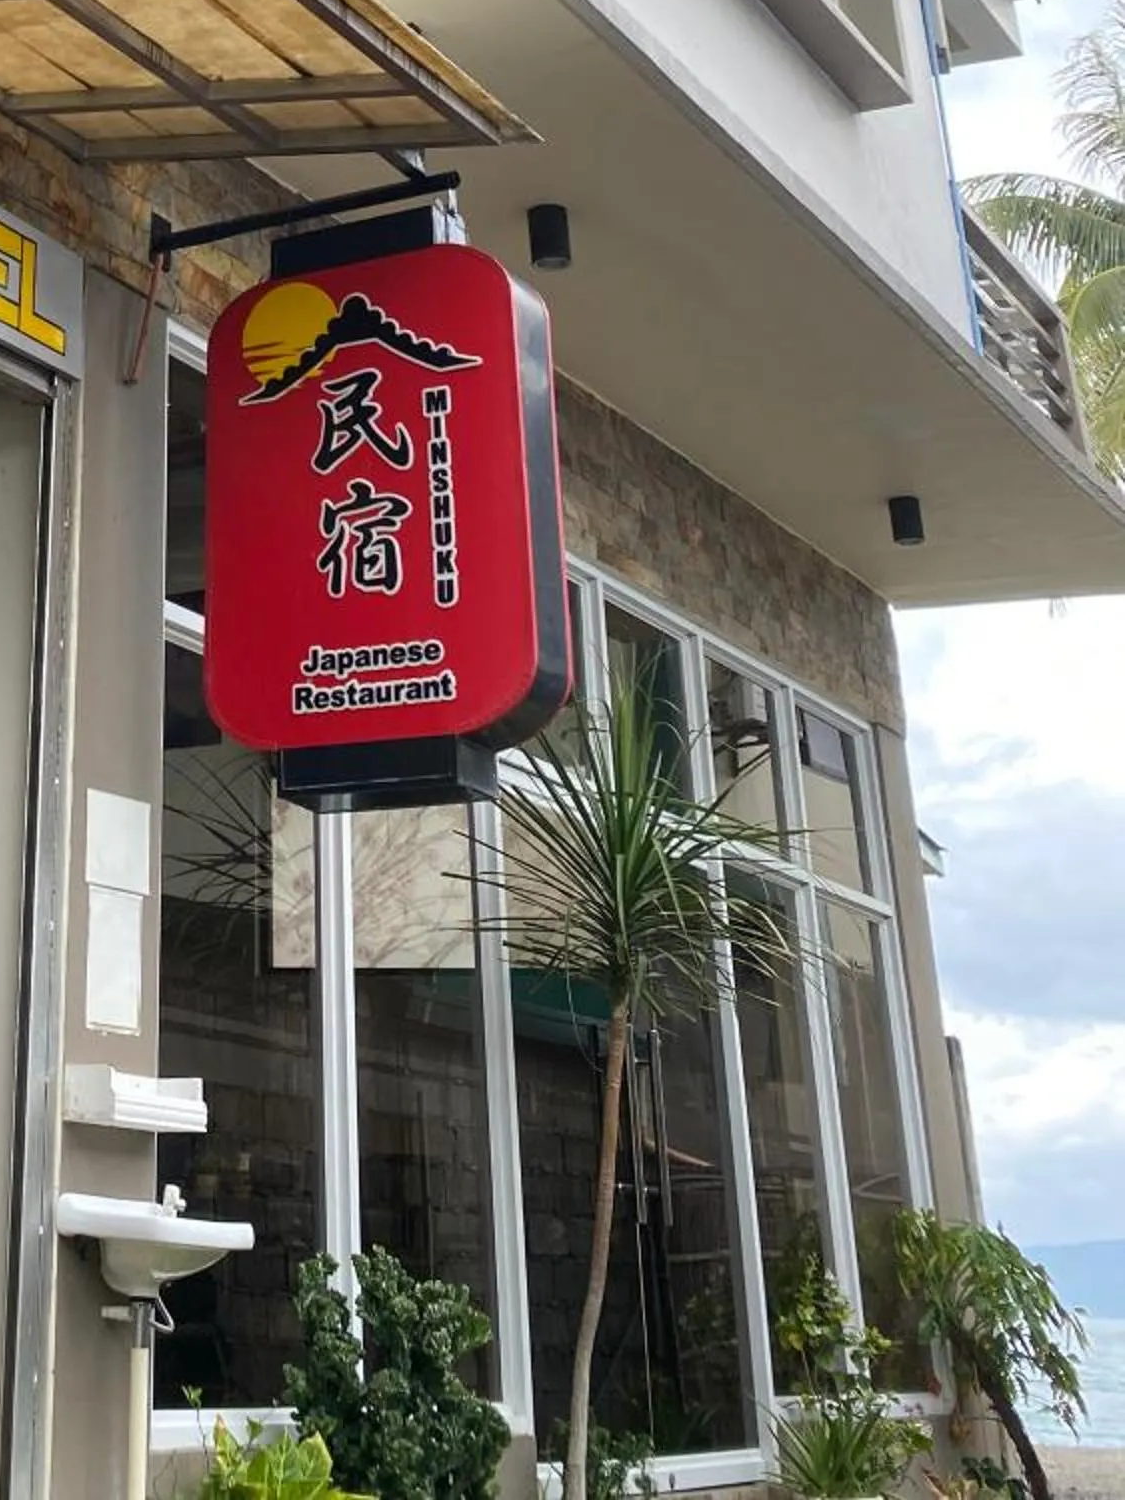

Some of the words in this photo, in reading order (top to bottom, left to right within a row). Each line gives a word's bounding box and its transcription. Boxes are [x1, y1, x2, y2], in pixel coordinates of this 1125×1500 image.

[313, 370, 412, 596] 民宿
[424, 387, 457, 606] MINSHUKU
[294, 673, 454, 713] Restaurant
[305, 641, 442, 676] Japanese
